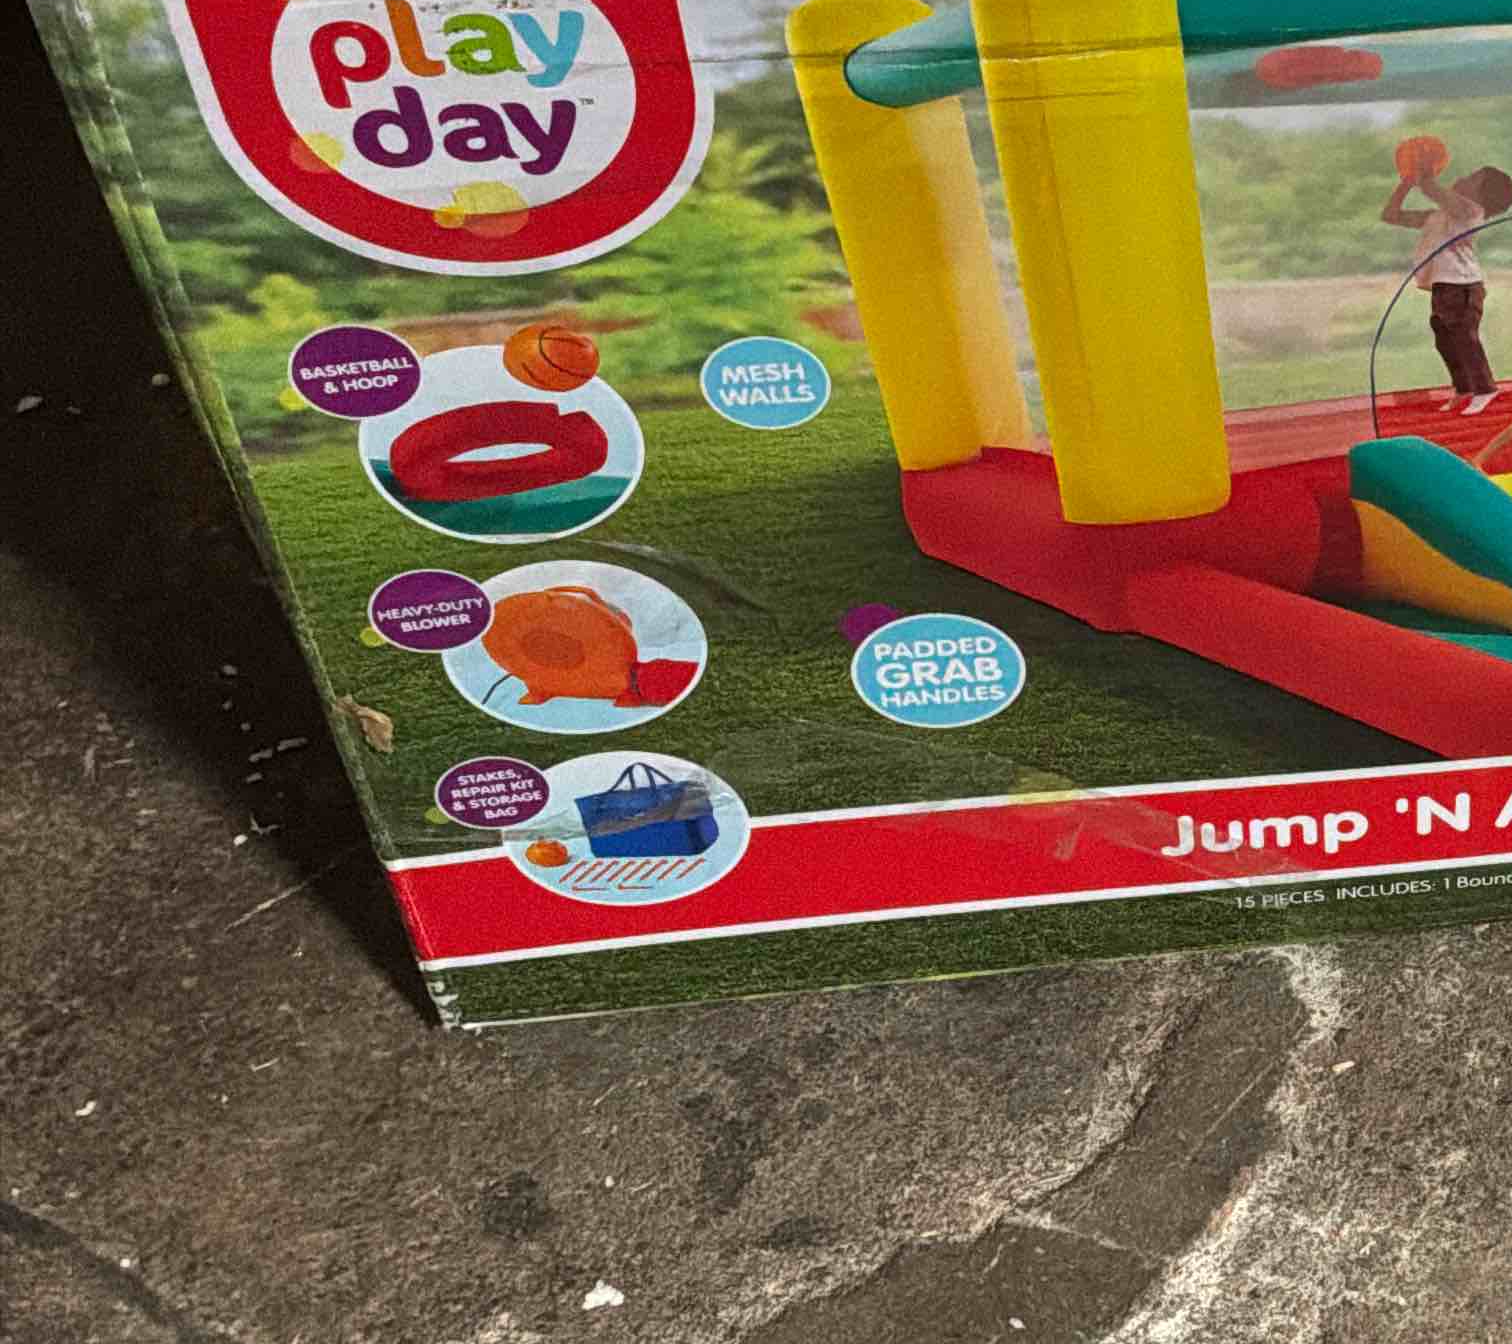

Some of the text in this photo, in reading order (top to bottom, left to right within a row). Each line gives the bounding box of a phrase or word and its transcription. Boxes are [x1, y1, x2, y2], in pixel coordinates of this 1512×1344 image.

[352, 85, 577, 176] day
[300, 357, 414, 380] BASKETBALL
[721, 363, 806, 385] MESH
[323, 374, 398, 394] & HOOP
[718, 383, 816, 407] WALLS
[377, 597, 483, 622] HEAVY-DUTY
[400, 613, 471, 632] BLOWER
[874, 636, 997, 661] PADDED
[876, 657, 1003, 688] GRAB
[880, 684, 1006, 708] HANDLES
[451, 778, 535, 799] REPAIR KIT
[452, 790, 542, 812] & STORAGE
[484, 806, 518, 819] BAG
[1160, 808, 1369, 857] Jump
[1395, 792, 1472, 835] 'N
[1234, 895, 1255, 909] 15
[1443, 877, 1450, 890] 1
